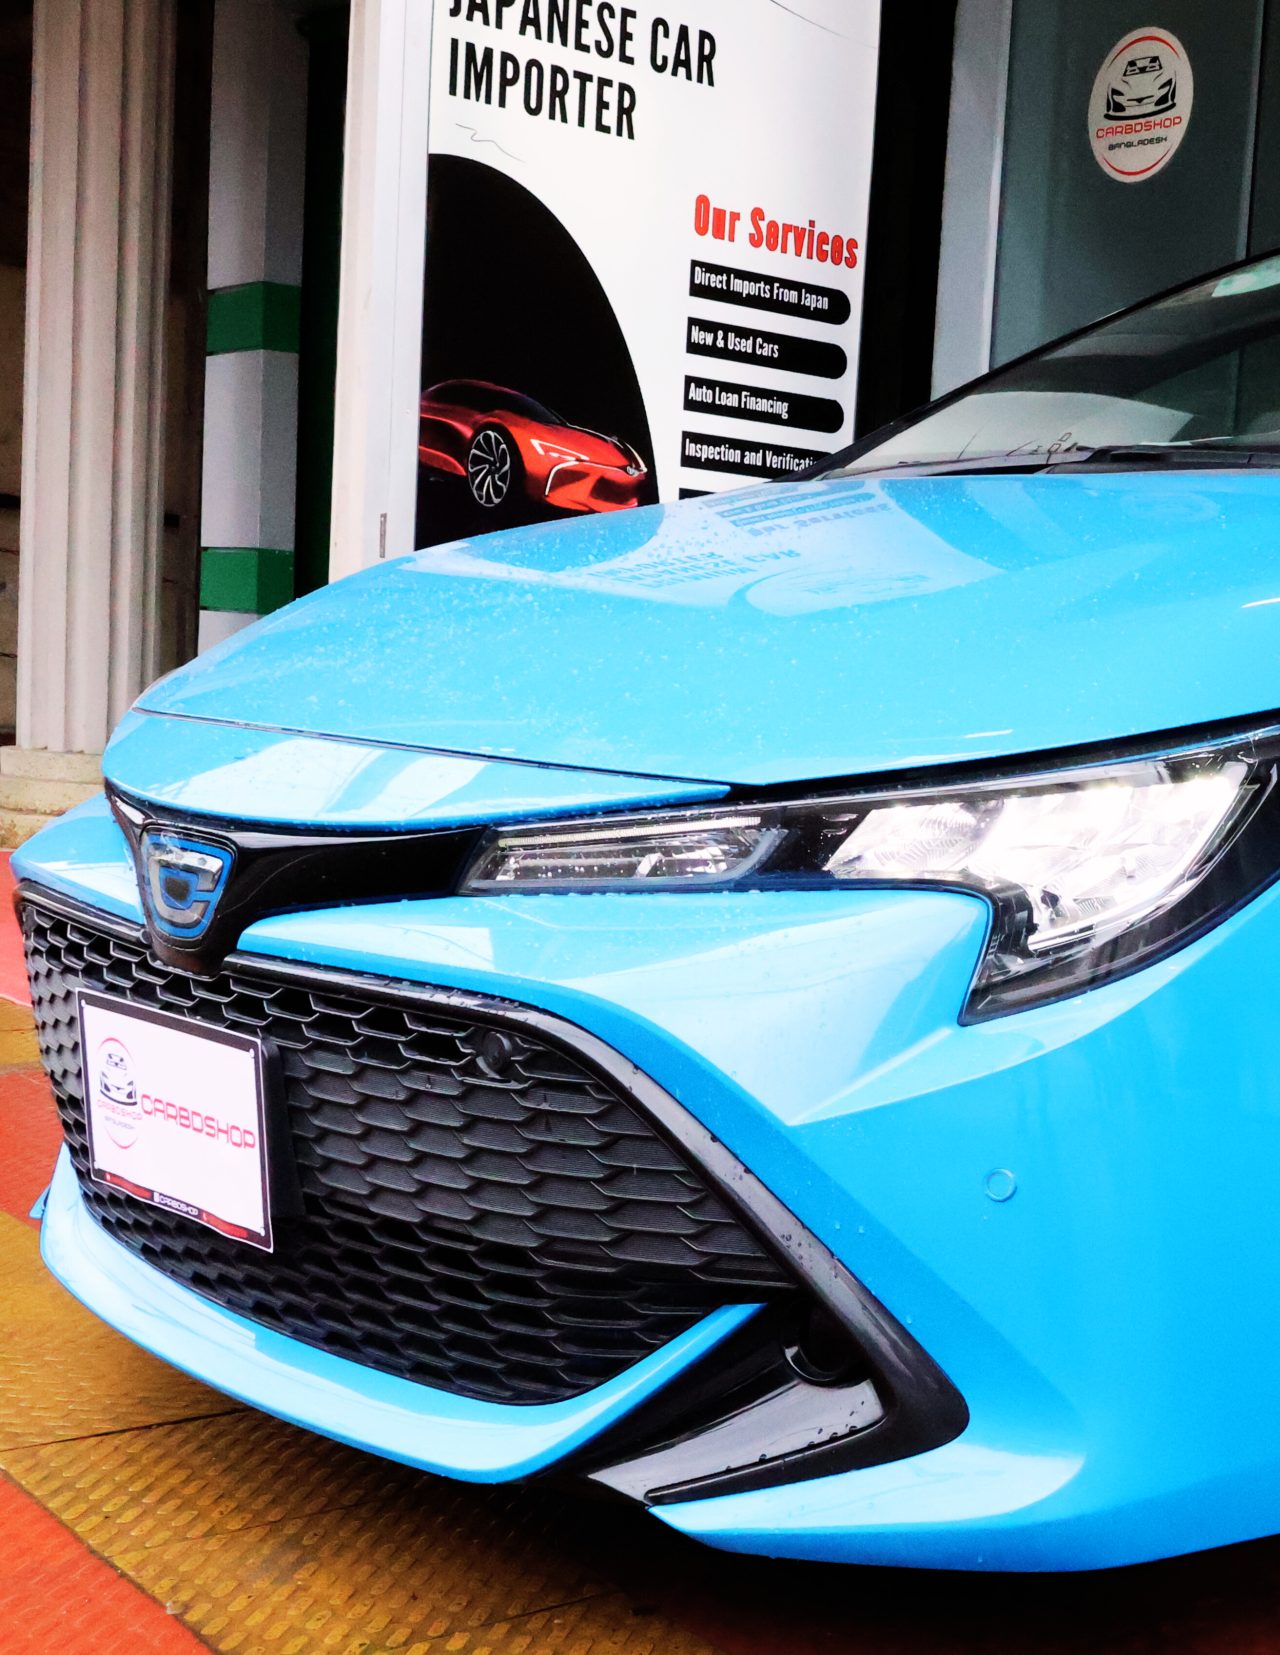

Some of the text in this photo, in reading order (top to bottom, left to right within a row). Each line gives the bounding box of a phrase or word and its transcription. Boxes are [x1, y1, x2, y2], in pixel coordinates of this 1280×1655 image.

[650, 17, 717, 87] CAR
[449, 37, 637, 140] IMPORTER
[1095, 116, 1182, 139] CARBDSHOP
[1107, 136, 1168, 151] BANGLADESH
[694, 194, 859, 269] Our Services
[694, 266, 829, 311] Direct Imports From Japan
[690, 325, 779, 358] New & Used Cars
[688, 382, 789, 419] Auto Loan Financing
[685, 438, 817, 472] Inspection and Verificati
[141, 1094, 256, 1150] CARBDSHOP
